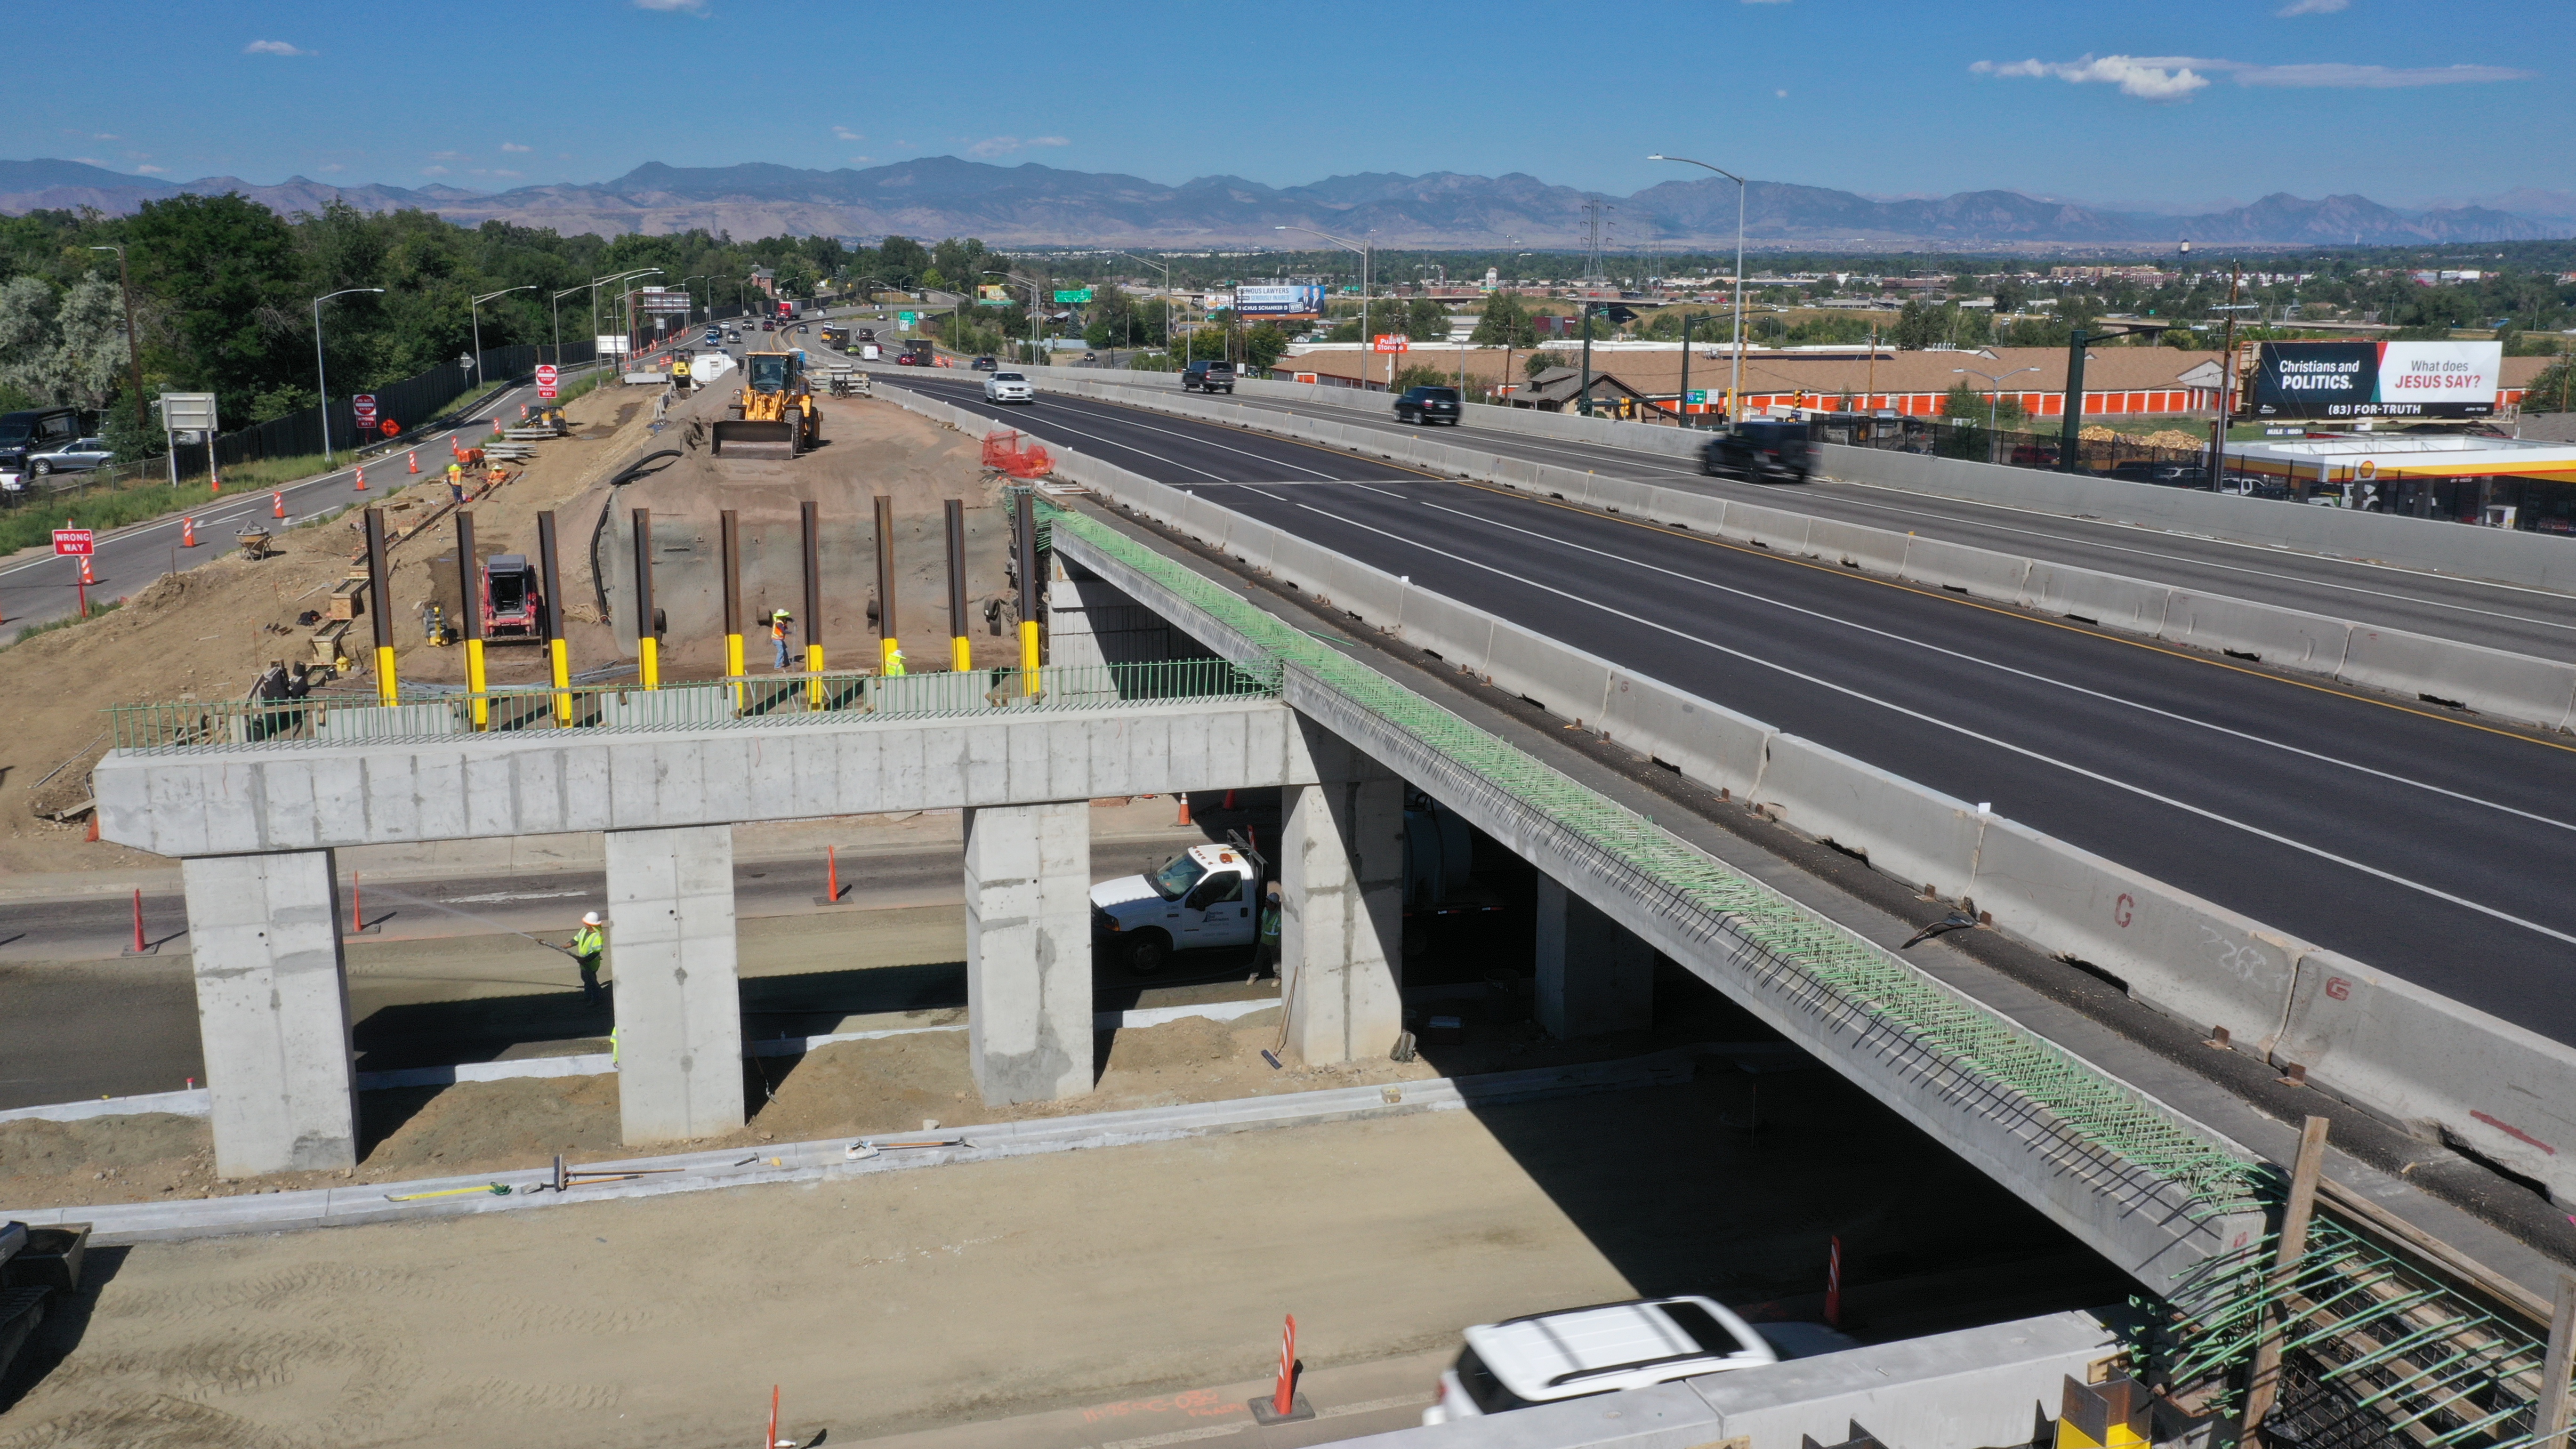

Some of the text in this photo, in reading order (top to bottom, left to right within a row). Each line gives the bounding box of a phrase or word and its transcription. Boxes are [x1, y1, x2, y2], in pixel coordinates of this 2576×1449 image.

[2279, 360, 2360, 373] Christians and
[2411, 360, 2469, 371] What does
[2281, 375, 2353, 390] POLITICS.
[2395, 375, 2481, 388] JESUS SAY?
[2328, 404, 2422, 416] (83) FOR-TRUTH
[55, 533, 90, 541] WRONG
[63, 543, 84, 551] WAY
